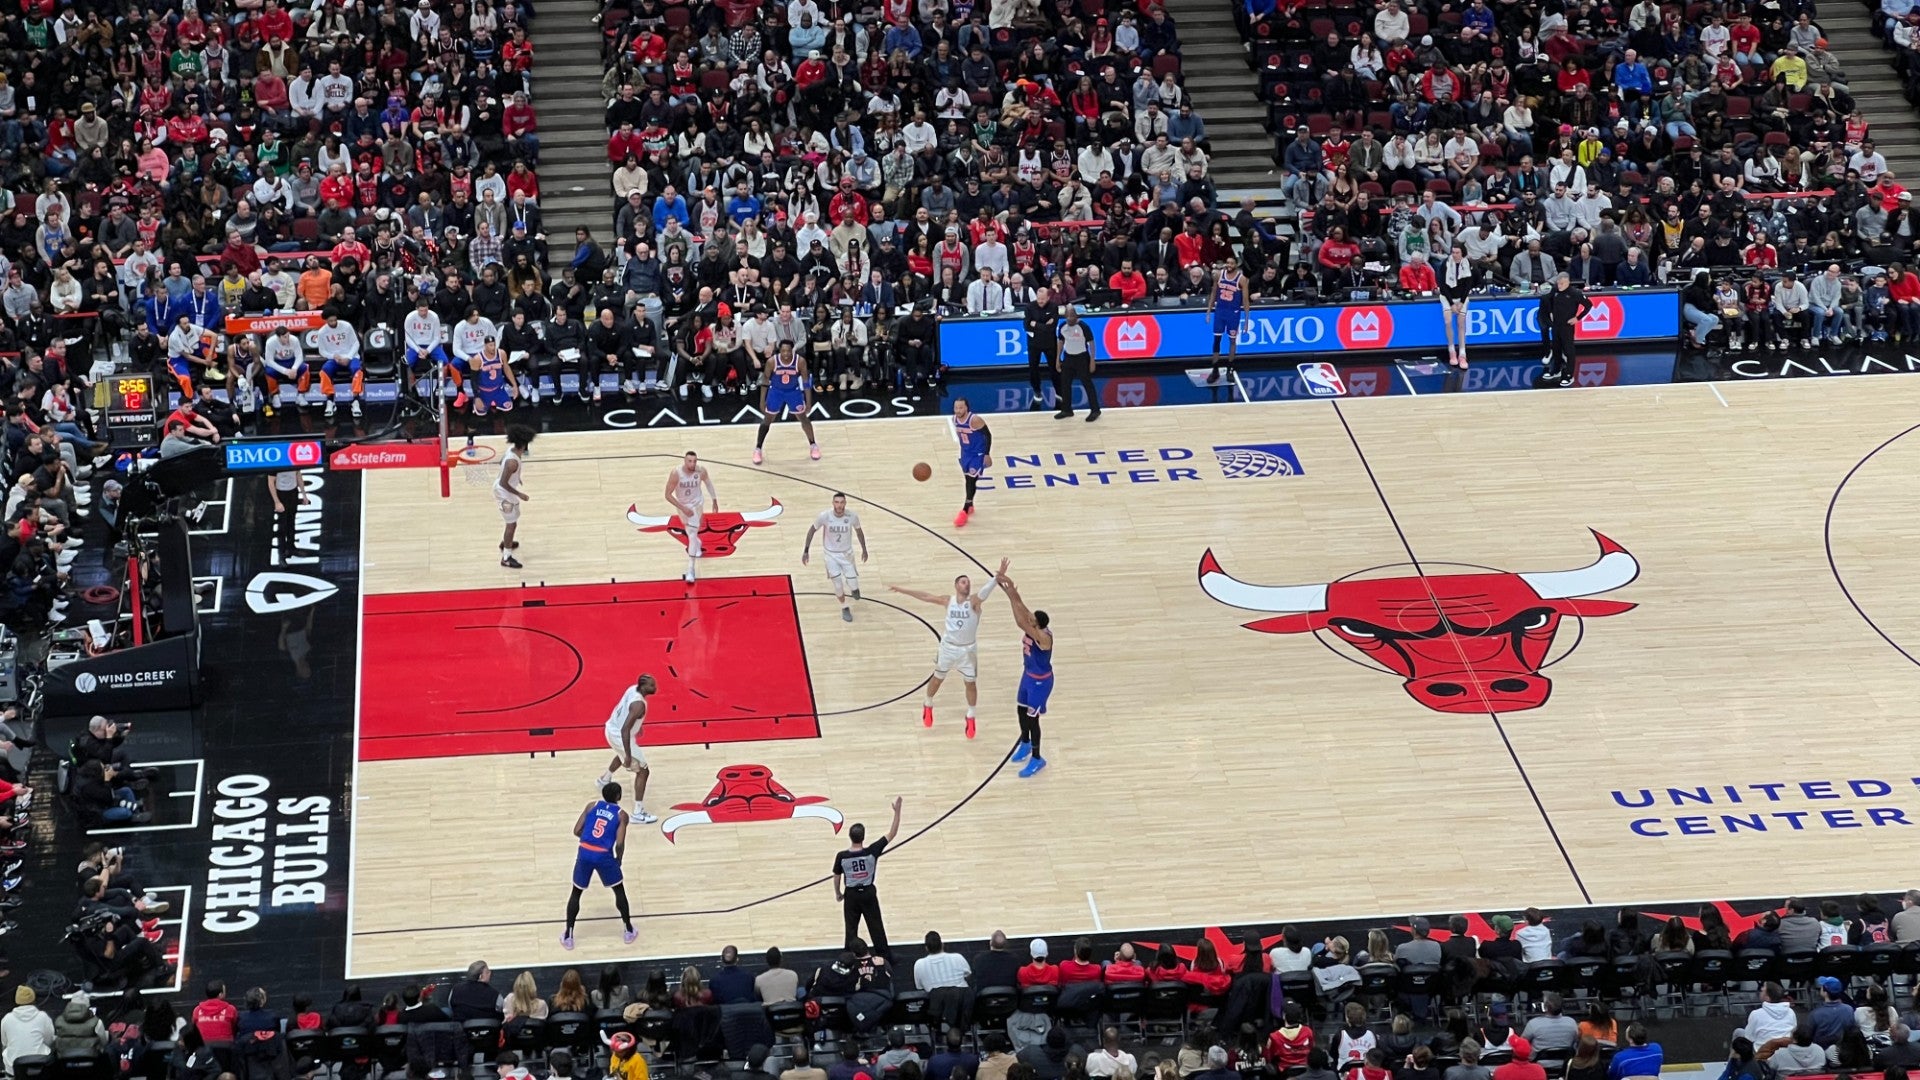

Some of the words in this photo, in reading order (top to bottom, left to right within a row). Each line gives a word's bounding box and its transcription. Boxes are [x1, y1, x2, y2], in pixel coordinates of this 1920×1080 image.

[250, 317, 309, 330] GATORADE
[1237, 316, 1324, 346] BMO
[119, 379, 147, 394] 2:56
[124, 393, 140, 409] 12
[121, 414, 152, 423] TISSOT
[228, 446, 281, 465] BMO
[1005, 447, 1194, 468] NITED
[950, 610, 970, 619] BULLS
[957, 620, 964, 630] 9
[98, 673, 133, 684] WIND
[135, 670, 174, 681] CREEK
[1610, 779, 1892, 808] UNITED
[592, 817, 608, 839] 5
[1630, 807, 1914, 837] CENTER
[202, 774, 270, 932] CHICAGO
[272, 796, 331, 907] BULLS
[852, 859, 866, 872] 26
